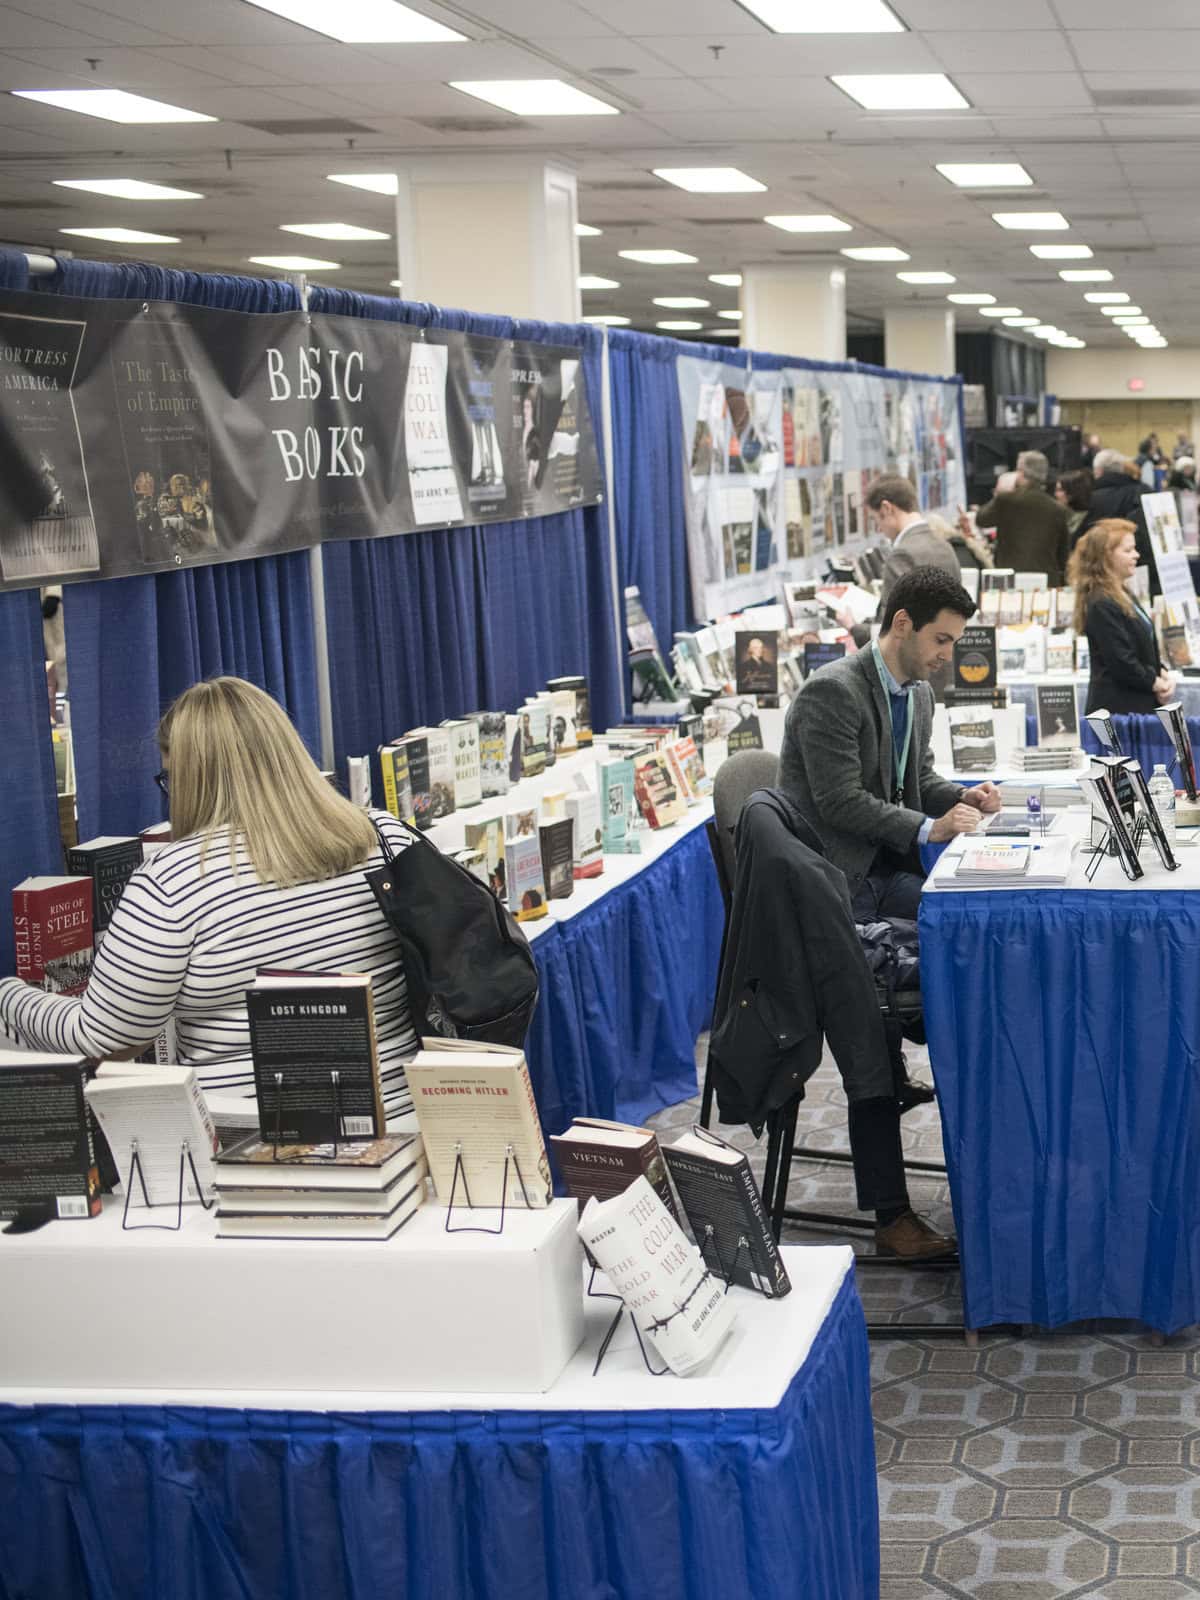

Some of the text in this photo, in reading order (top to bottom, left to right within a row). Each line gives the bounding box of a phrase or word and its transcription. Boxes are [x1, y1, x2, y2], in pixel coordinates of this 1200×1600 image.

[123, 361, 151, 382] The
[5, 375, 58, 391] AMERICA
[127, 393, 200, 416] of Empire
[50, 897, 85, 915] RING OF
[47, 910, 89, 934] STEEL
[15, 916, 31, 976] STEEL
[32, 922, 41, 953] RING
[270, 1004, 348, 1016] LOST KINGDOM
[421, 1087, 509, 1096] BECOMING HITLER
[572, 1152, 625, 1168] VIETNAM
[629, 1195, 656, 1226] THE
[741, 1169, 761, 1217] EMPRESS
[762, 1233, 777, 1258] EAST
[591, 1226, 616, 1244] WESTAD
[643, 1216, 673, 1255] COLD
[609, 1256, 635, 1275] THE
[660, 1243, 687, 1275] WAR
[618, 1270, 651, 1294] COLD
[630, 1289, 659, 1309] WAR
